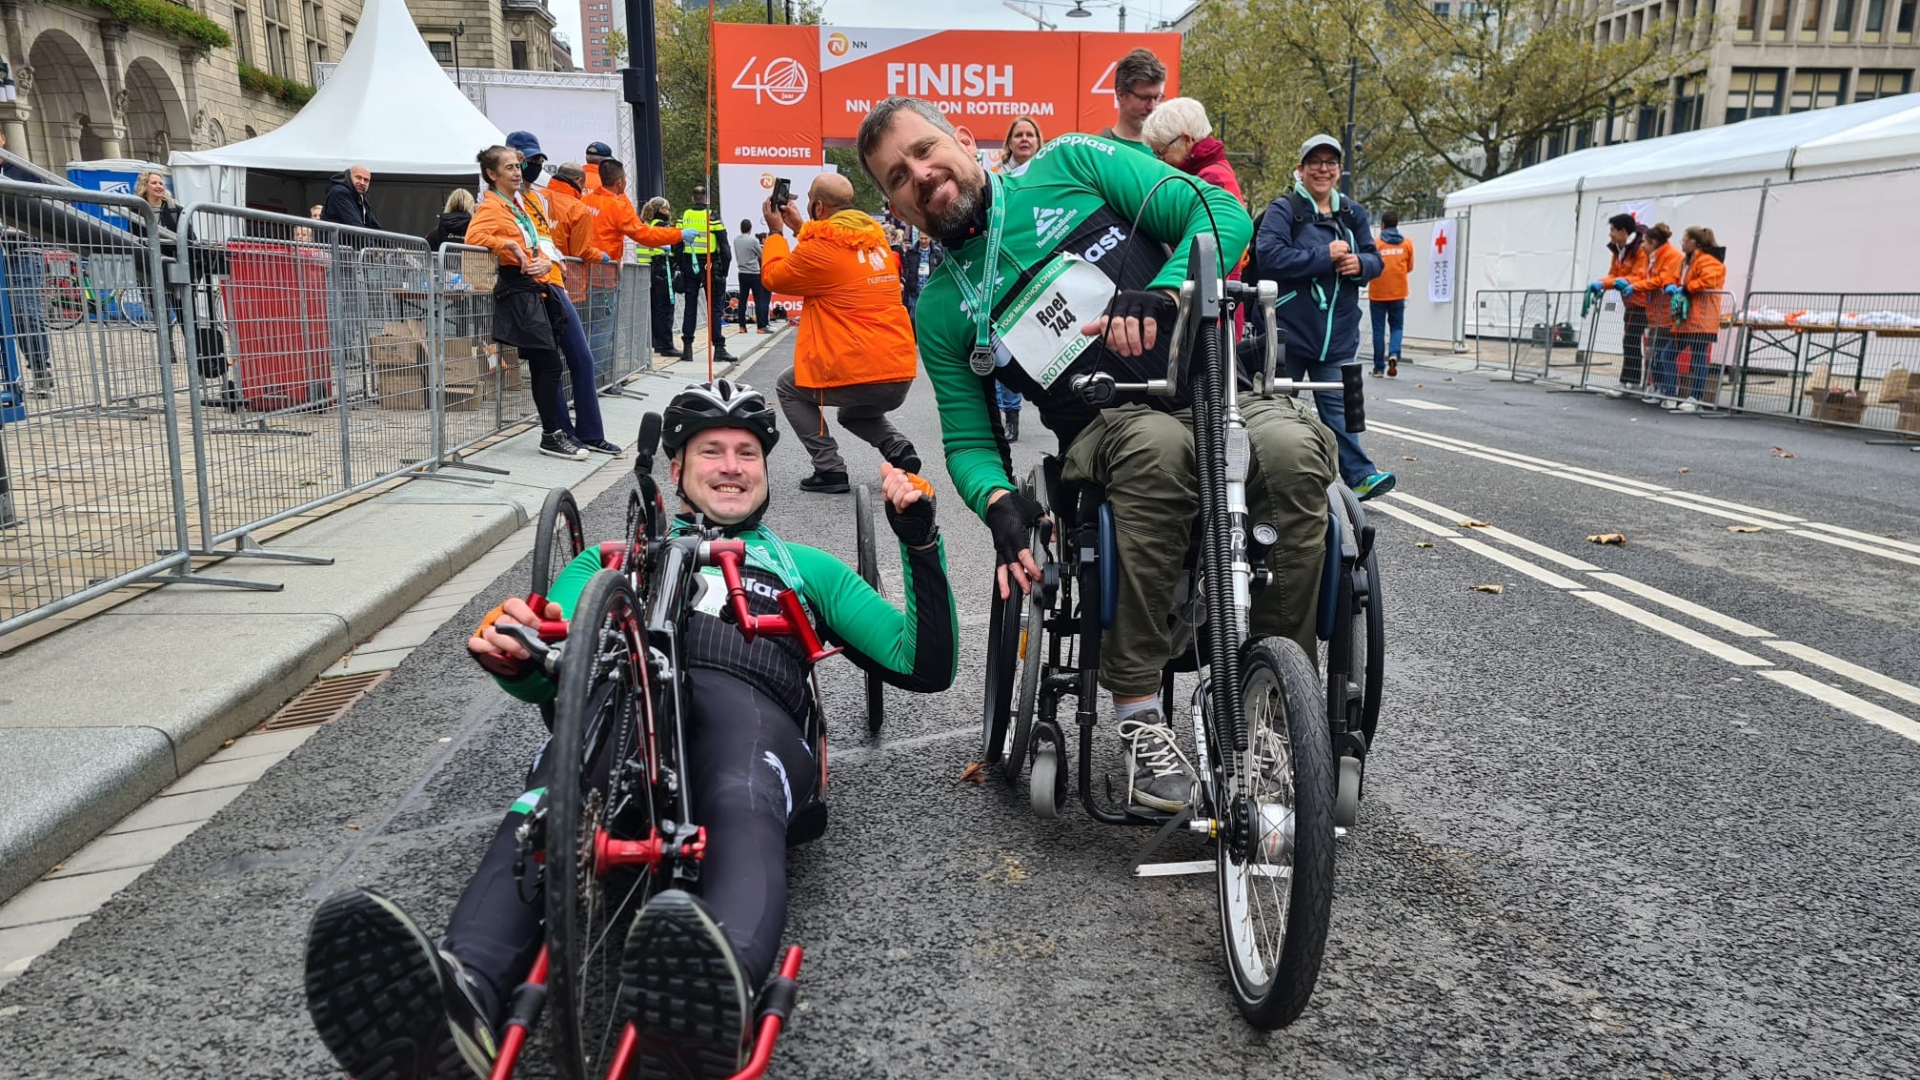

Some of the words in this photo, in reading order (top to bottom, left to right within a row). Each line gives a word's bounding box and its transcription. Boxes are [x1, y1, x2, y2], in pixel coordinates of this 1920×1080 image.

[852, 41, 868, 49] NN
[887, 62, 1014, 97] FINISH
[845, 99, 871, 113] NN
[966, 101, 1054, 116] ROTTERDAM
[734, 146, 811, 158] #DEMOOISTE
[1035, 135, 1117, 160] Coloplast
[1000, 313, 1016, 330] YOUR
[1013, 283, 1042, 315] MARATHON
[1040, 258, 1068, 284] CHALLEN
[1441, 260, 1449, 296] Rode
[1035, 291, 1068, 327] Roel
[1048, 308, 1077, 338] 744
[1041, 333, 1096, 387] ROTTERDA
